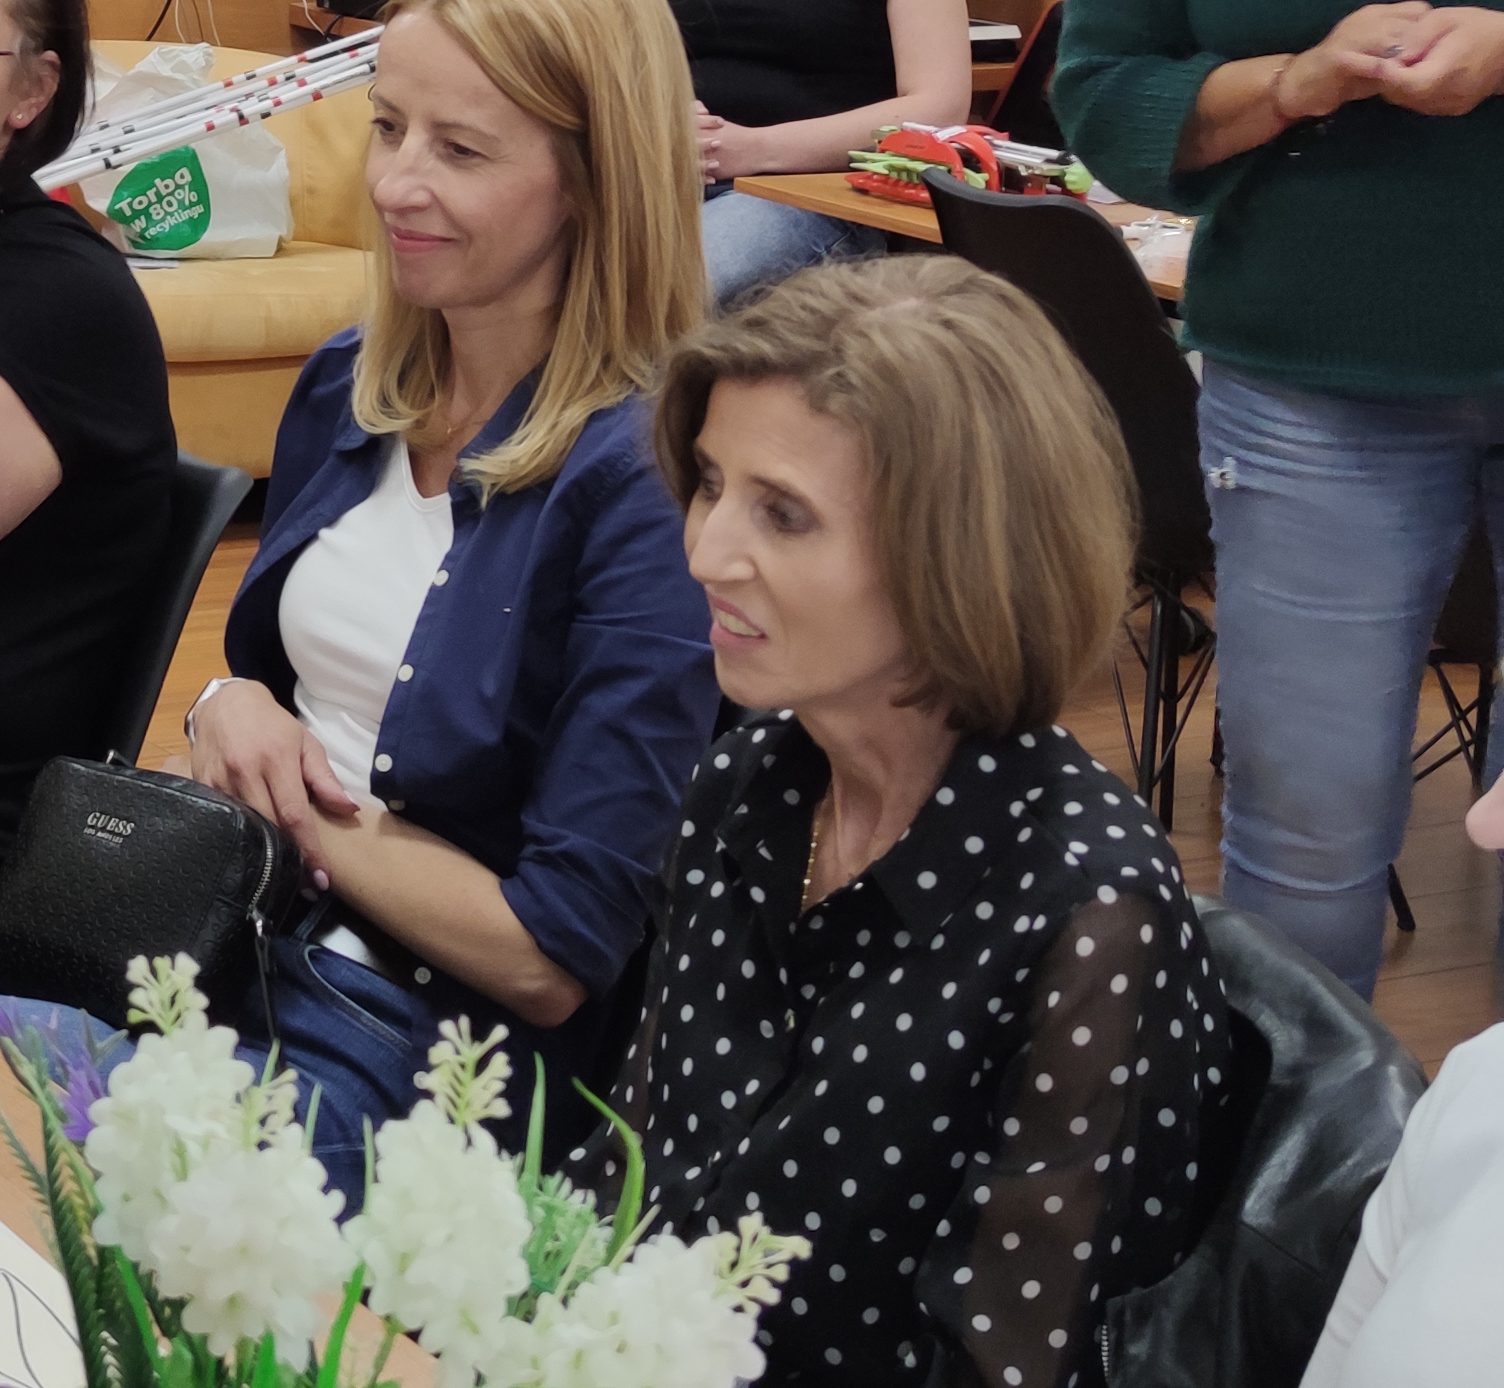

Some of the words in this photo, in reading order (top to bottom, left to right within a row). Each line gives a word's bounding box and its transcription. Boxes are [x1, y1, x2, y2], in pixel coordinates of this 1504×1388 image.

[114, 166, 192, 217] Torba
[148, 186, 199, 221] 80%
[144, 202, 205, 240] recyklingu
[87, 811, 135, 836] GUESS
